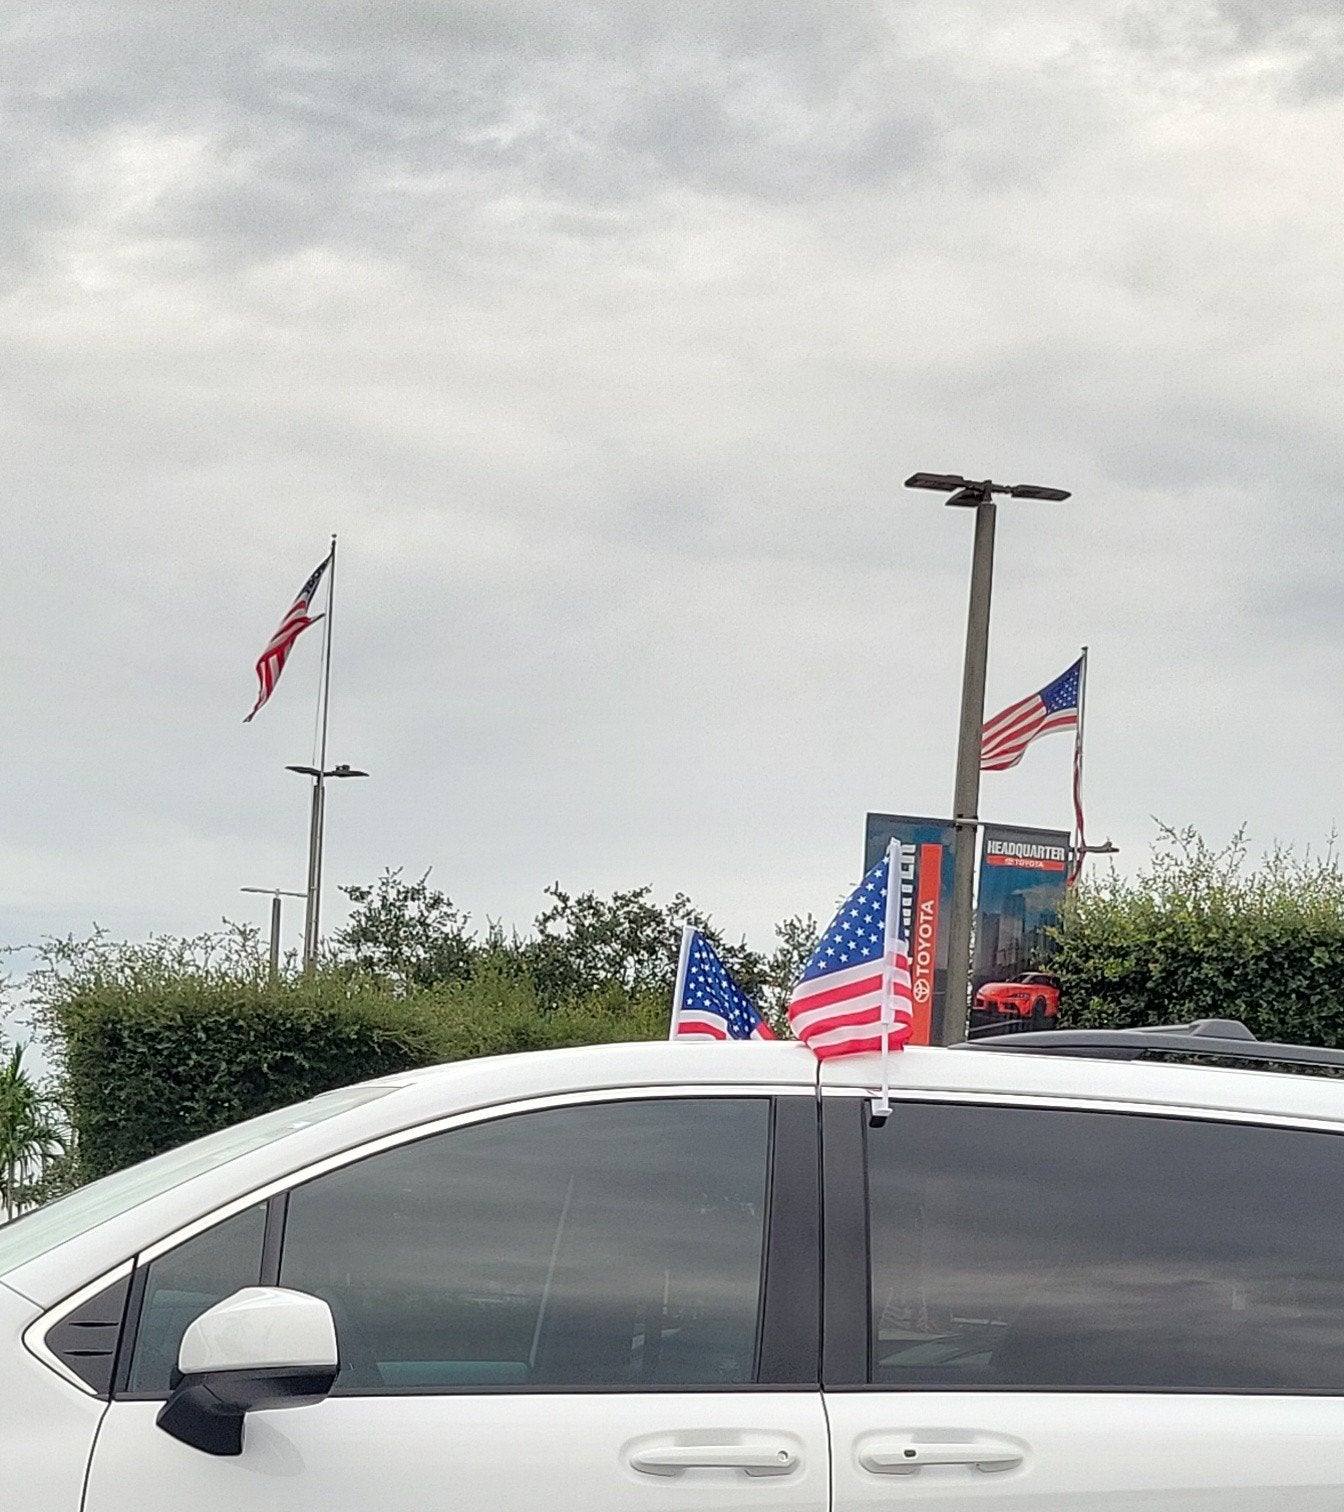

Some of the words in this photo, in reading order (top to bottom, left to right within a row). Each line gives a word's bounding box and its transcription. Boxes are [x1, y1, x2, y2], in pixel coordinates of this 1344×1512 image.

[987, 840, 1065, 861] HEADQUARTER
[1016, 858, 1044, 869] TOYOTA
[916, 900, 935, 977] TOYOTA
